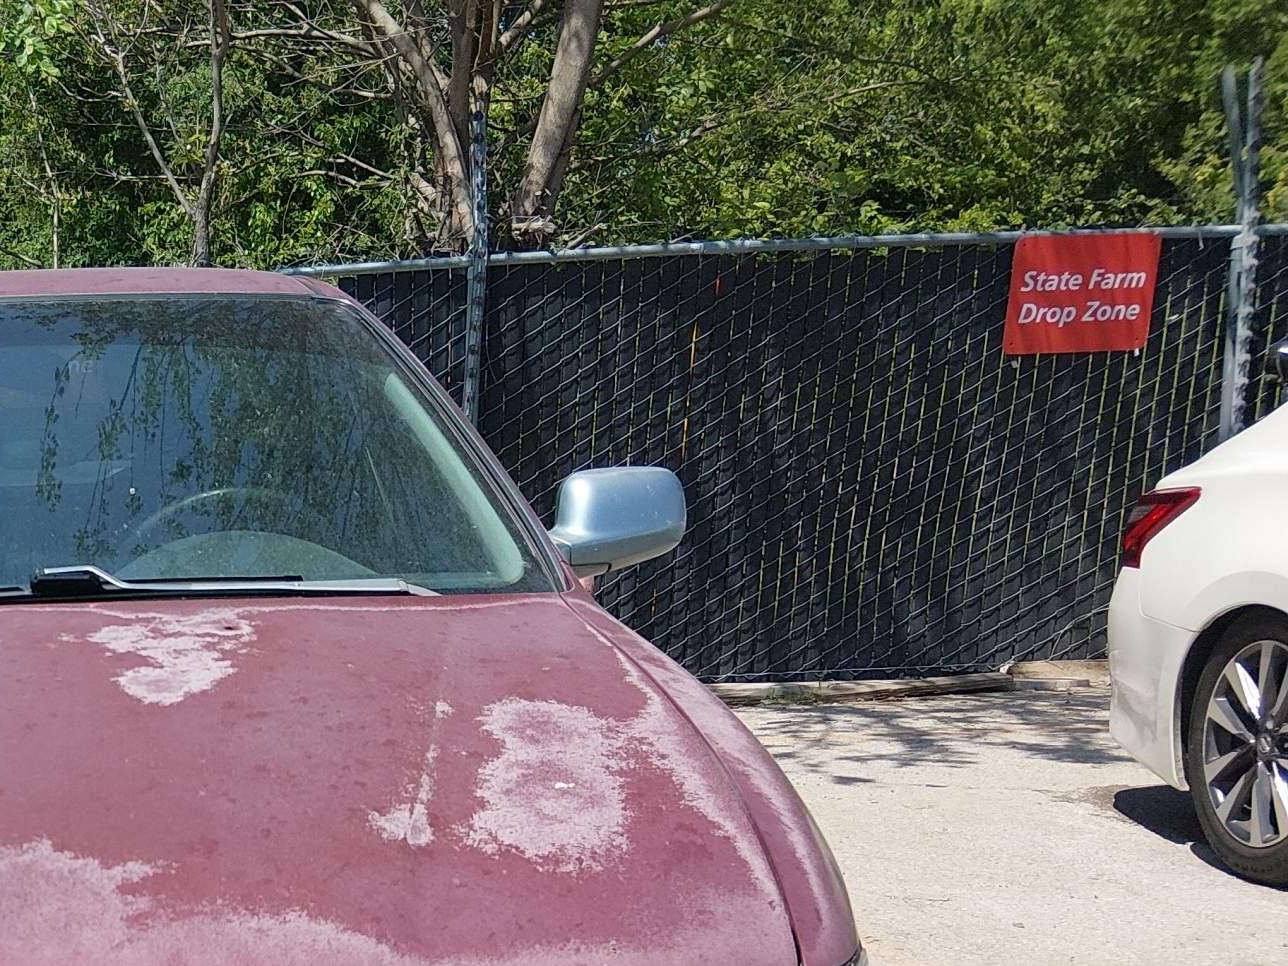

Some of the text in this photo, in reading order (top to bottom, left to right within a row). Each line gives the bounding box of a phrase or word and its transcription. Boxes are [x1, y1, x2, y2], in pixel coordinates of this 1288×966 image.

[1020, 268, 1146, 292] State Farm
[1018, 300, 1141, 328] Drop Zone
